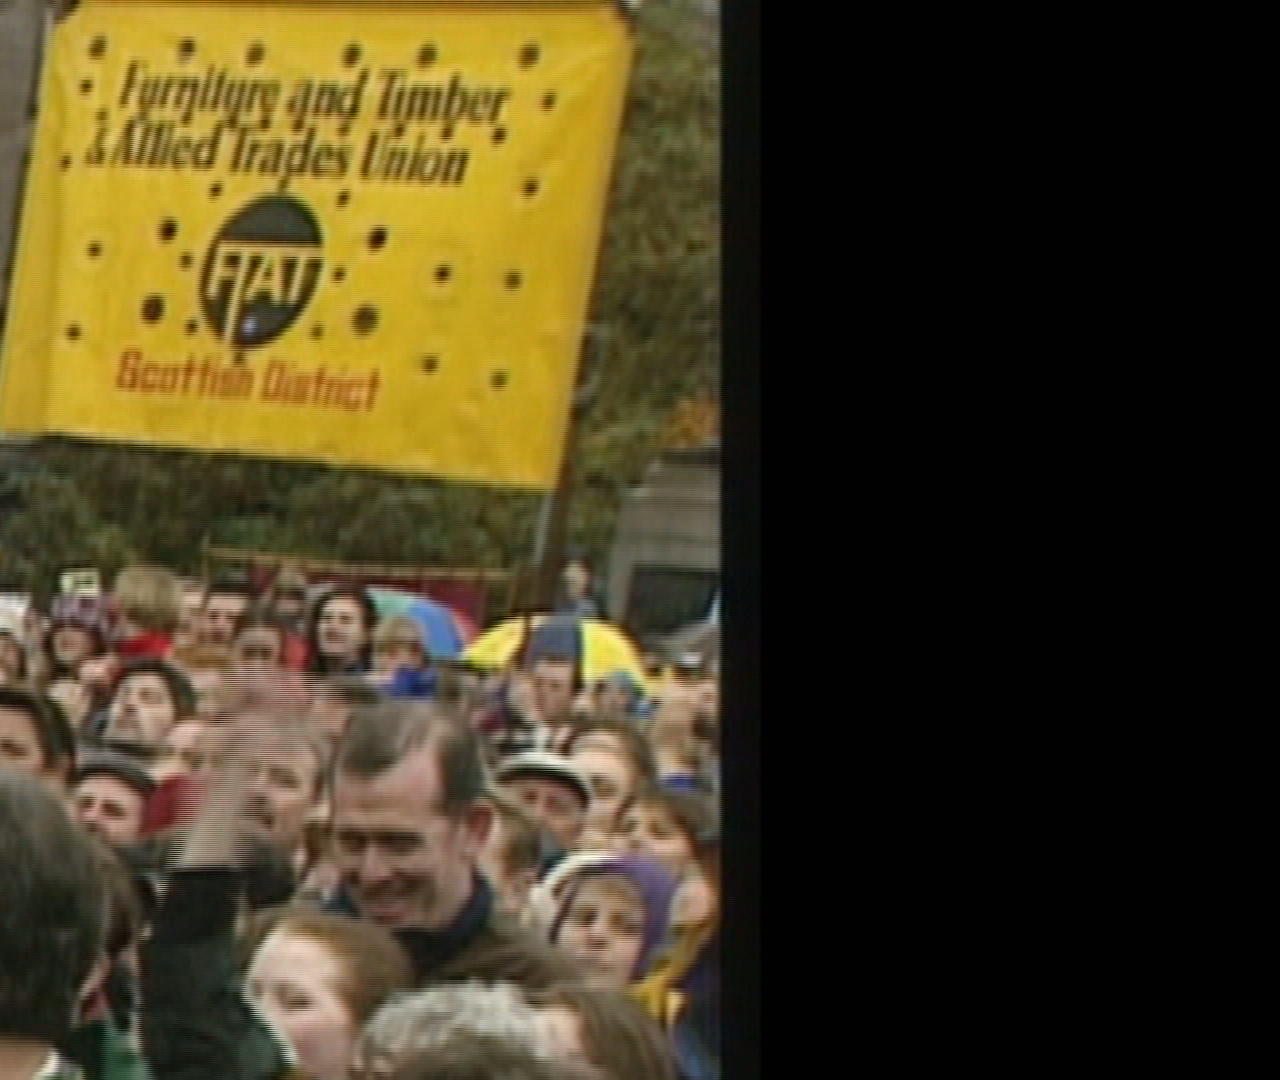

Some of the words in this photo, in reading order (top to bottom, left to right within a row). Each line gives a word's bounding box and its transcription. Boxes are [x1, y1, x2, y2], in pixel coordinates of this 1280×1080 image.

[120, 60, 279, 114] Furniture
[289, 69, 369, 121] and
[378, 68, 507, 122] Timber
[112, 122, 220, 169] Allied
[230, 132, 348, 179] Trades
[360, 134, 468, 184] Union
[117, 351, 252, 400] Scottish
[261, 360, 379, 411] District
